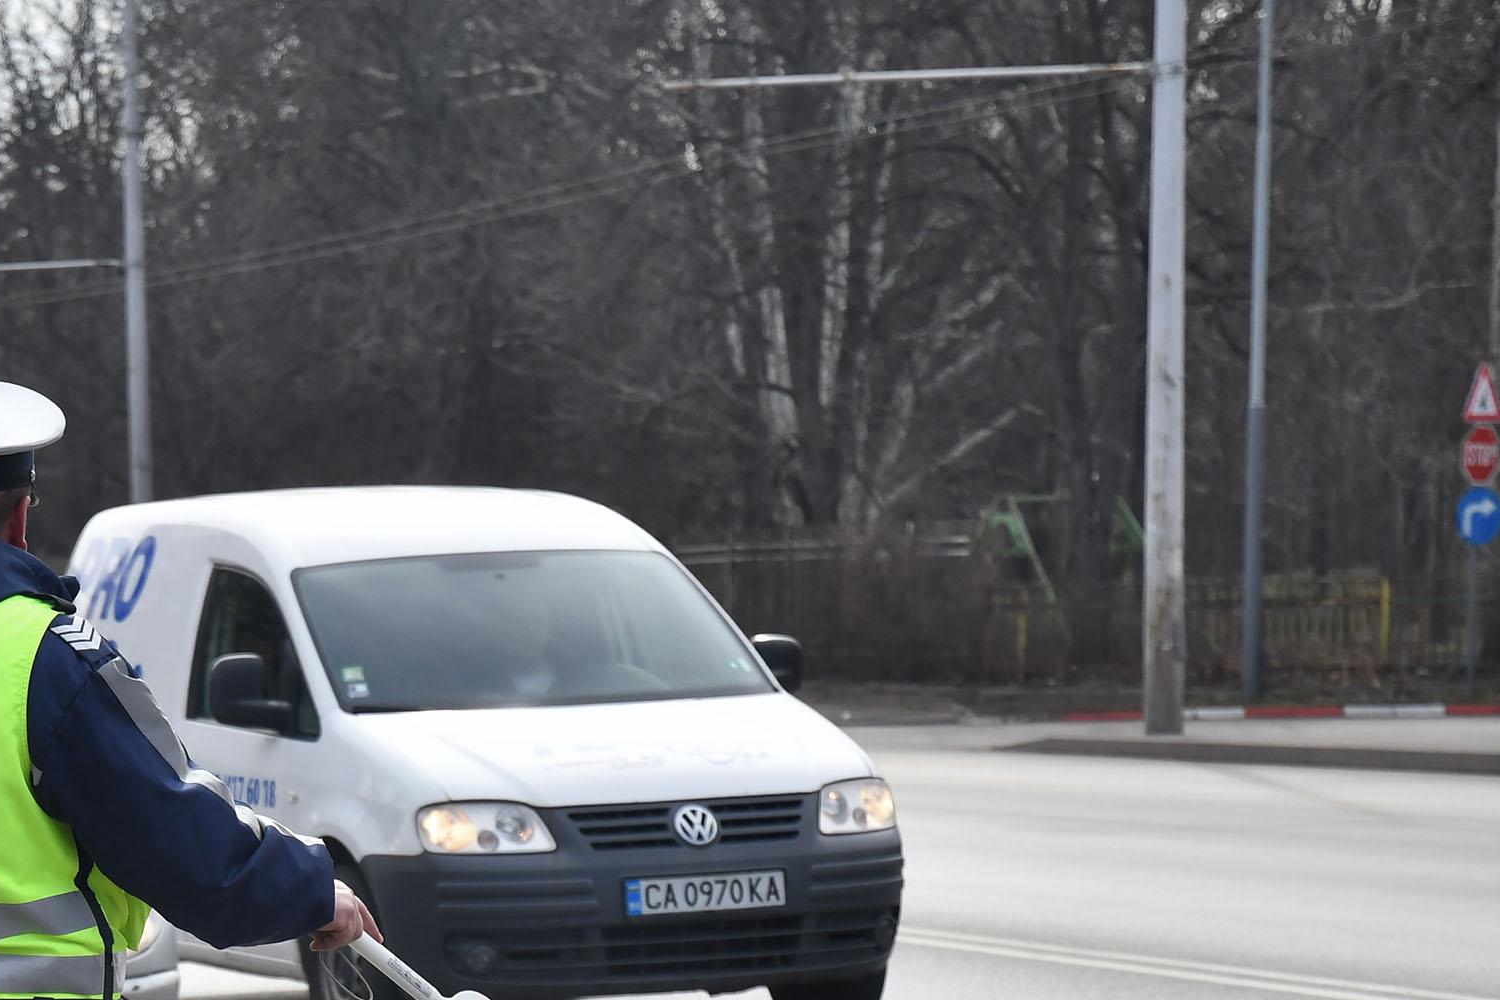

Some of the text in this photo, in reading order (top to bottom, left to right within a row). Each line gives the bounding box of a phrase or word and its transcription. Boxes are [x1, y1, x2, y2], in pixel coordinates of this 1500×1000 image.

[263, 780, 276, 808] 18
[645, 877, 780, 909] CA 0970 KA
